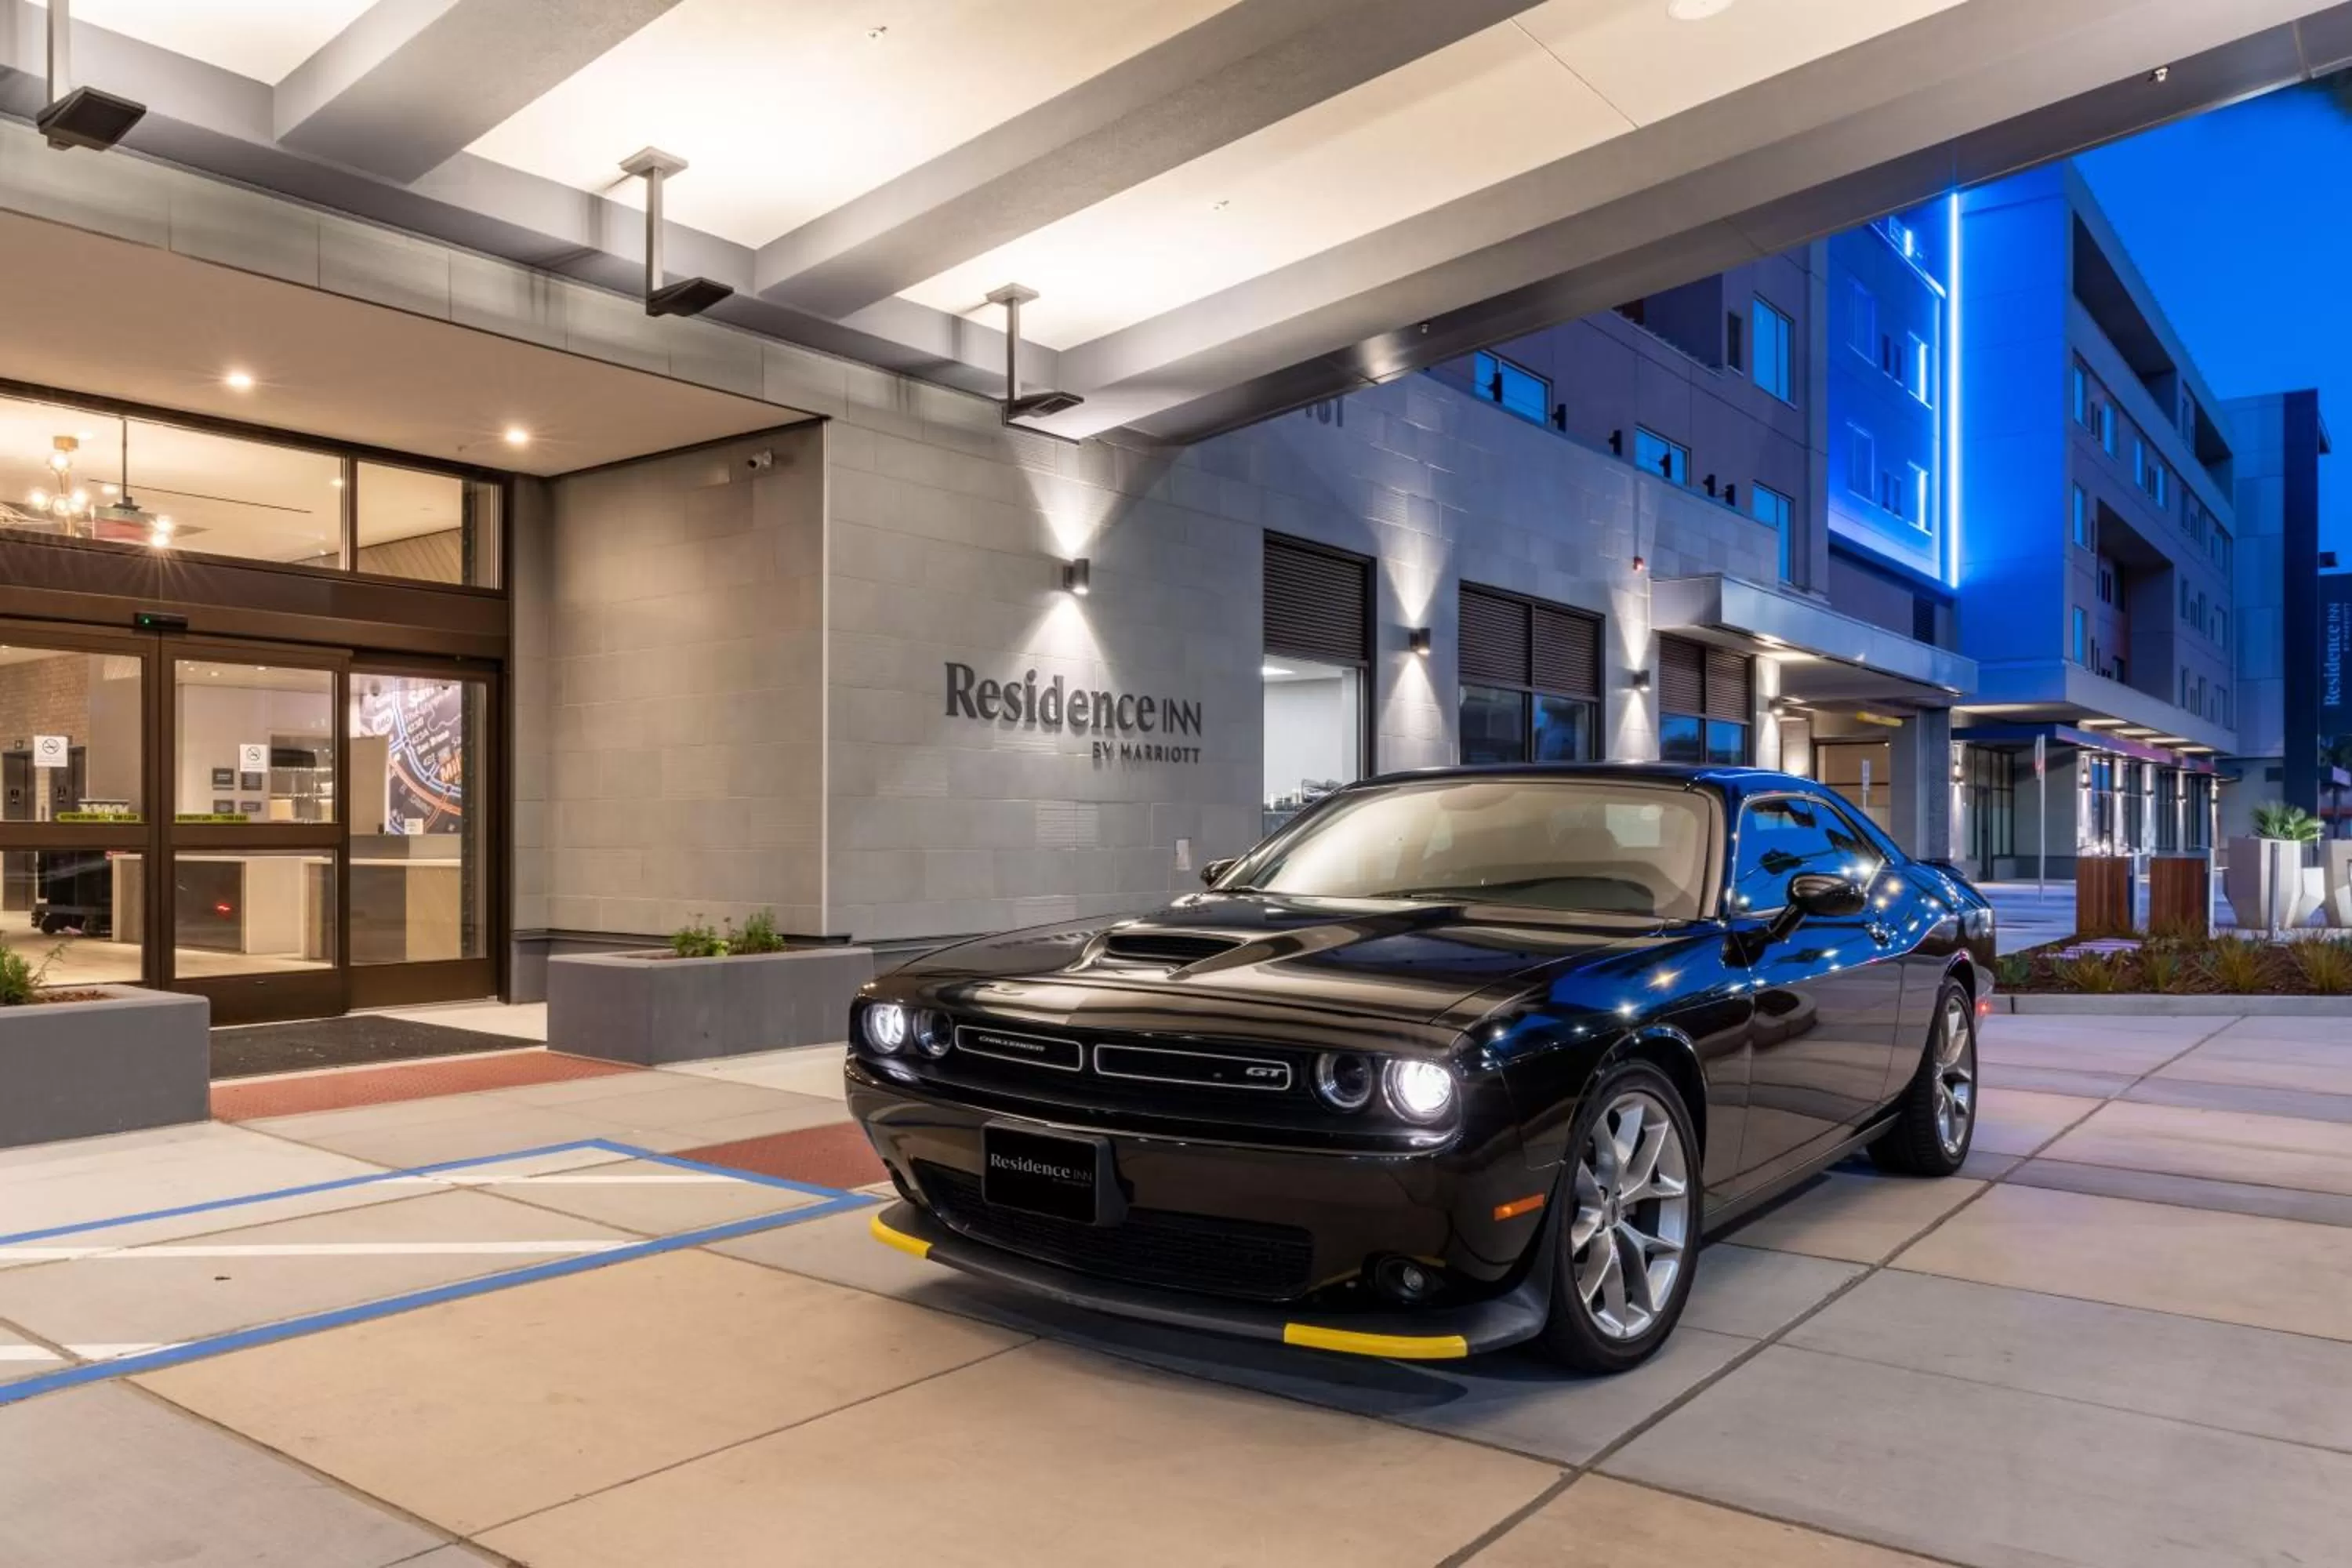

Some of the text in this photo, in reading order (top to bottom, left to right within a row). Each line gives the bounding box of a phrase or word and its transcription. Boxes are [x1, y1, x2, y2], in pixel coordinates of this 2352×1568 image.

[2324, 624, 2340, 705] Residence
[945, 662, 1201, 736] Residence INN
[1093, 741, 1201, 764] BY MARRIOTT
[1246, 1067, 1287, 1077] GT
[991, 1152, 1092, 1181] Residence INN
